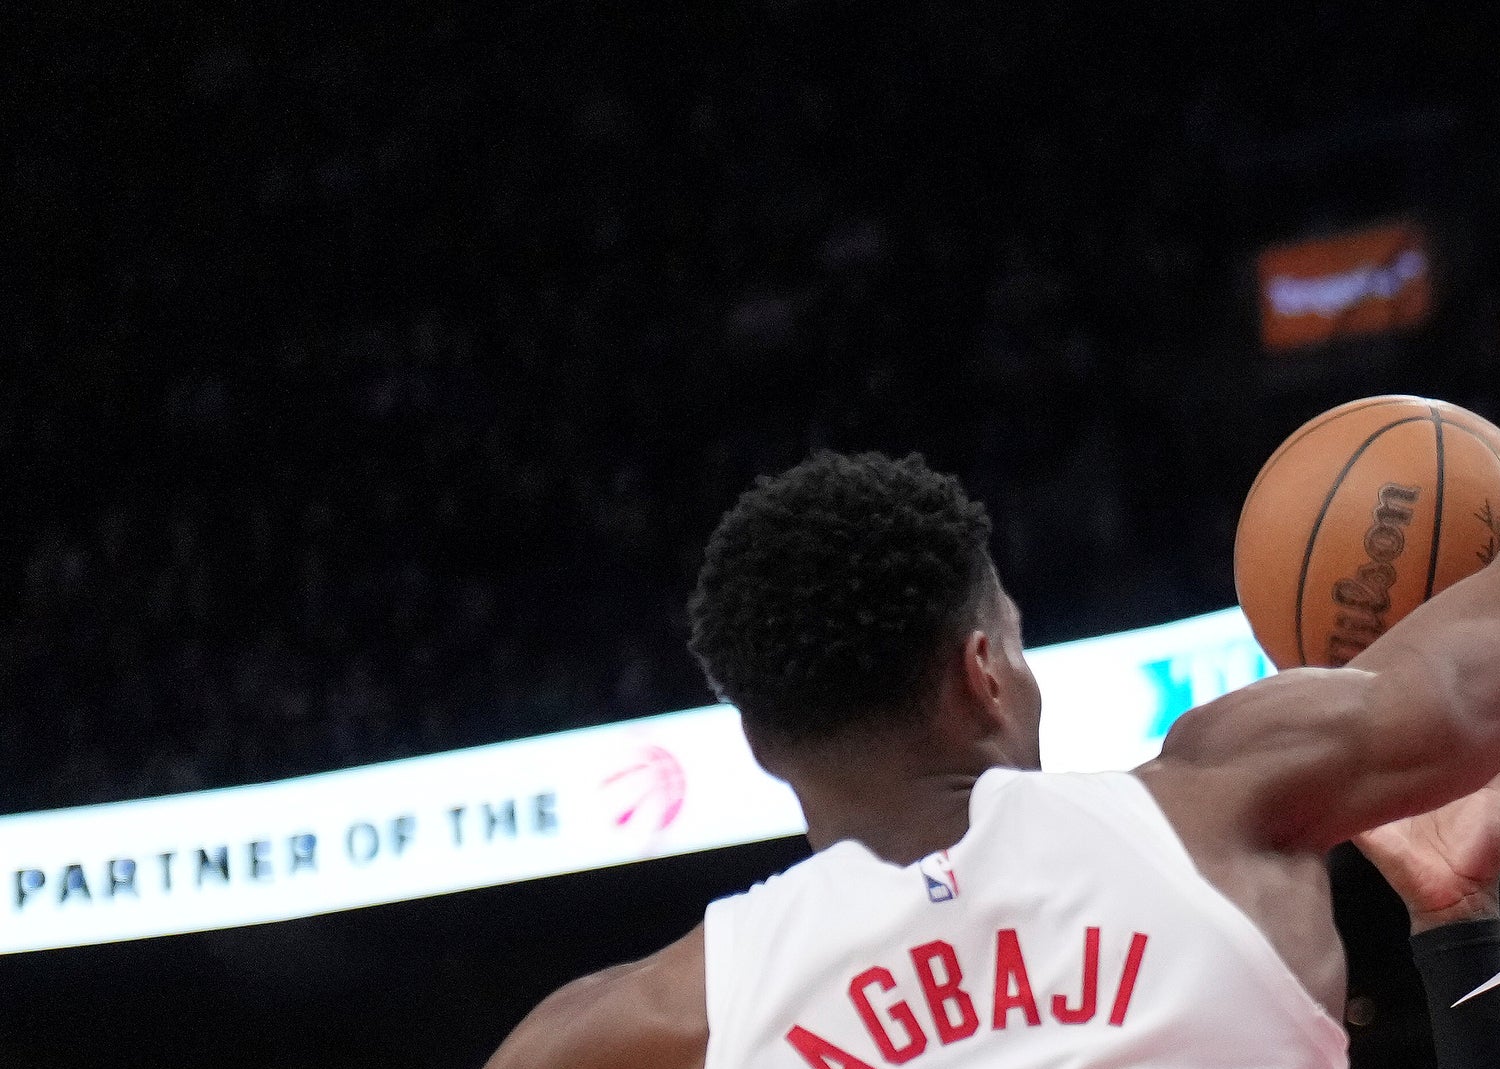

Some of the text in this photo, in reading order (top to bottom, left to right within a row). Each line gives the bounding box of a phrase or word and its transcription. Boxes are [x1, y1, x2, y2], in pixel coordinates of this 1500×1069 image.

[12, 790, 561, 912] PARTNER OF THE
